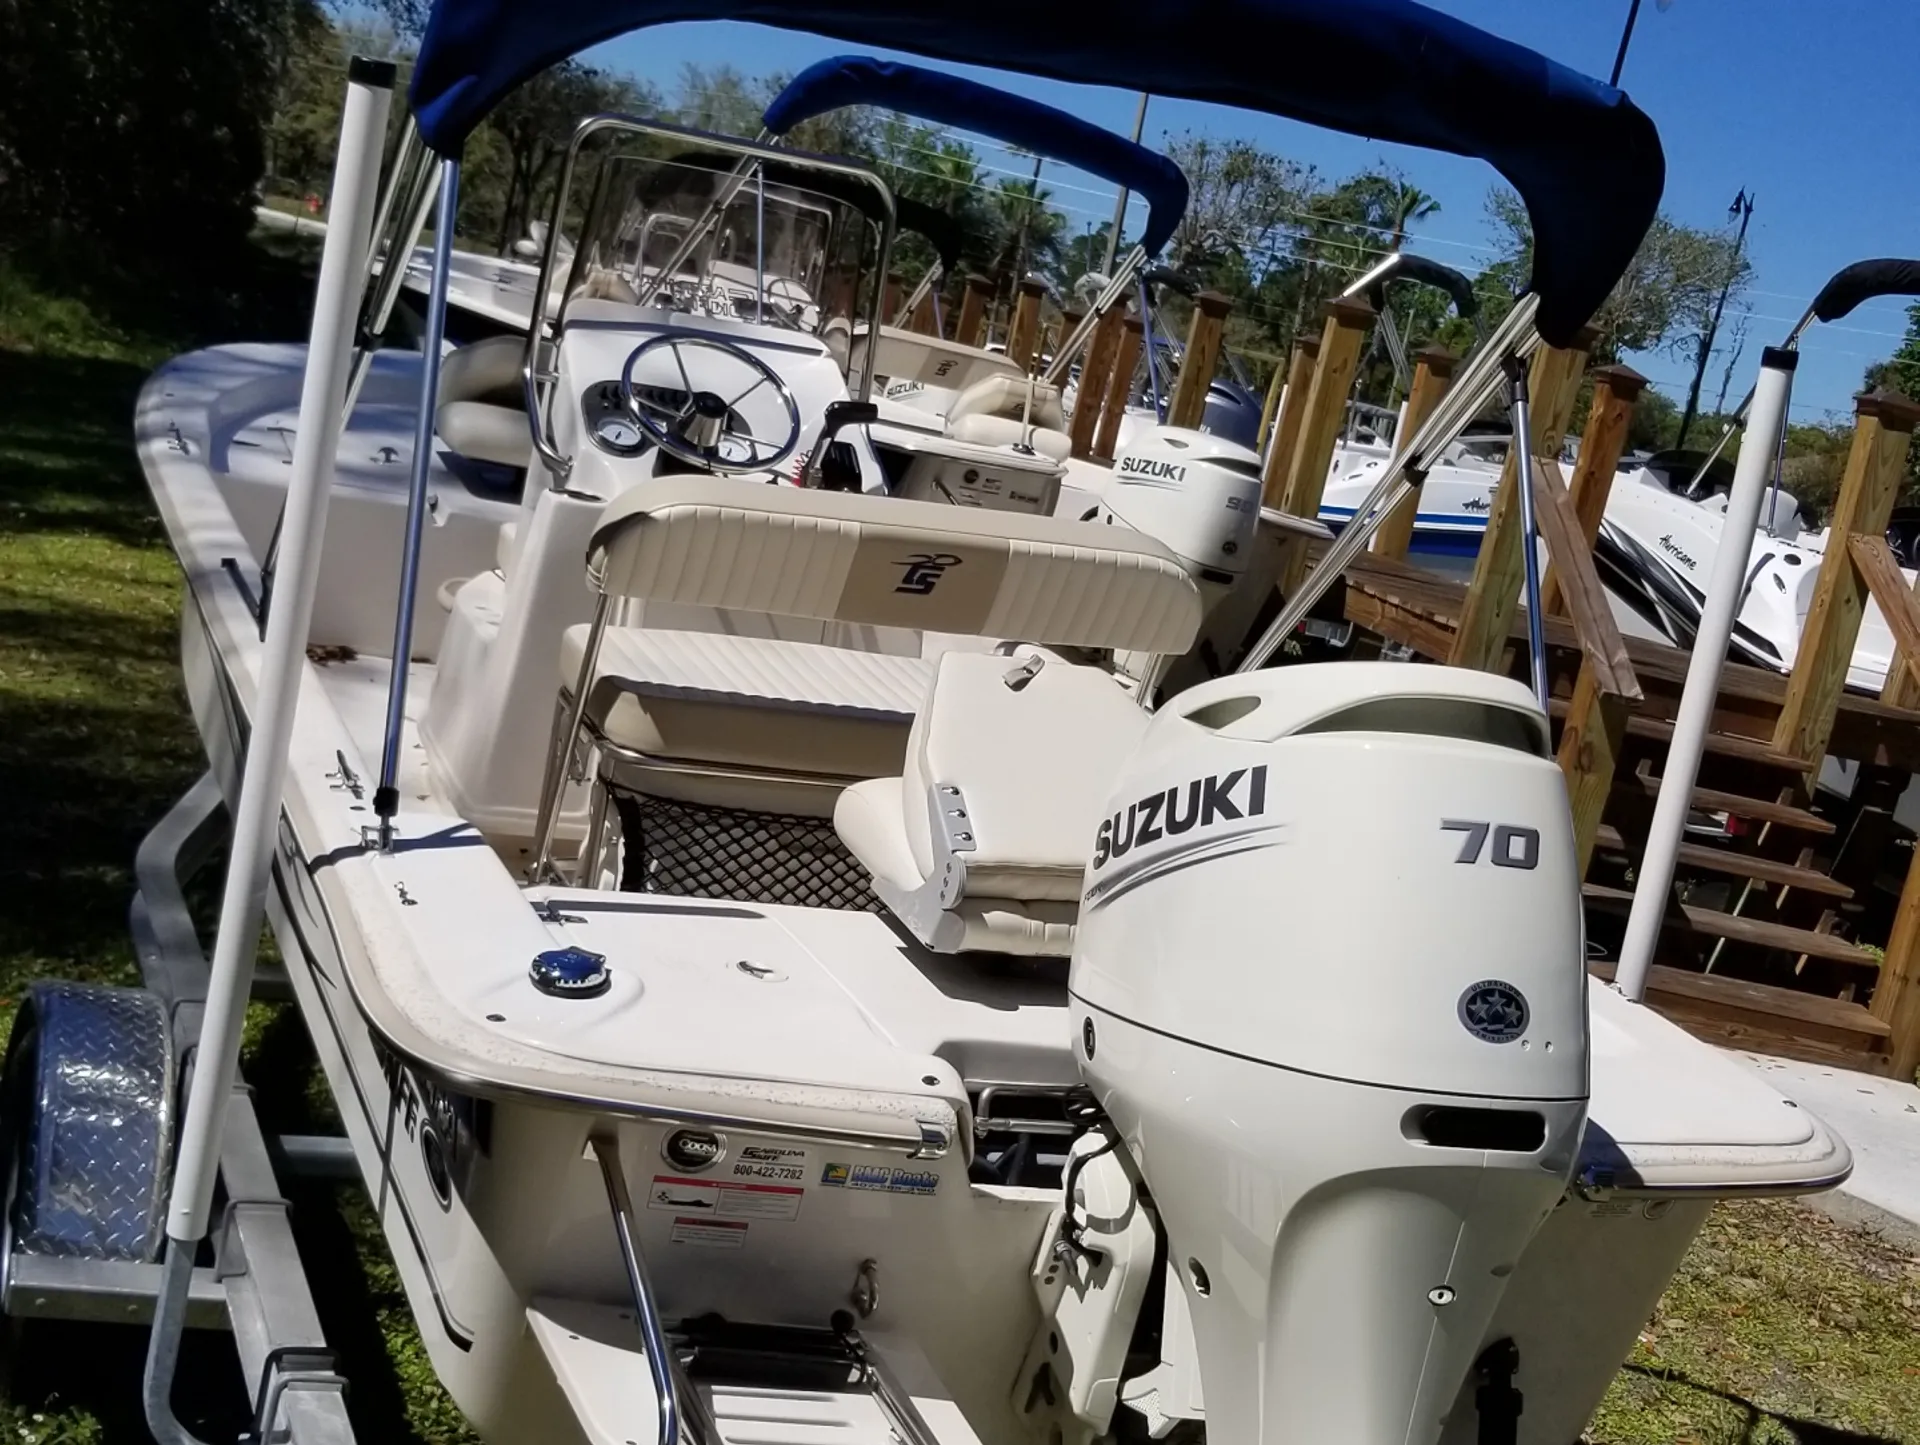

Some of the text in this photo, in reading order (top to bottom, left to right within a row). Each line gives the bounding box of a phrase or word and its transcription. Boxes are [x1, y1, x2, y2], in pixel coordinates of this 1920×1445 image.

[1121, 457, 1186, 482] SUZUKI
[1658, 534, 1697, 571] Hurricane
[1093, 764, 1267, 870] SUZUKI
[1439, 818, 1540, 870] 70
[733, 1163, 803, 1180] 800-422-7282
